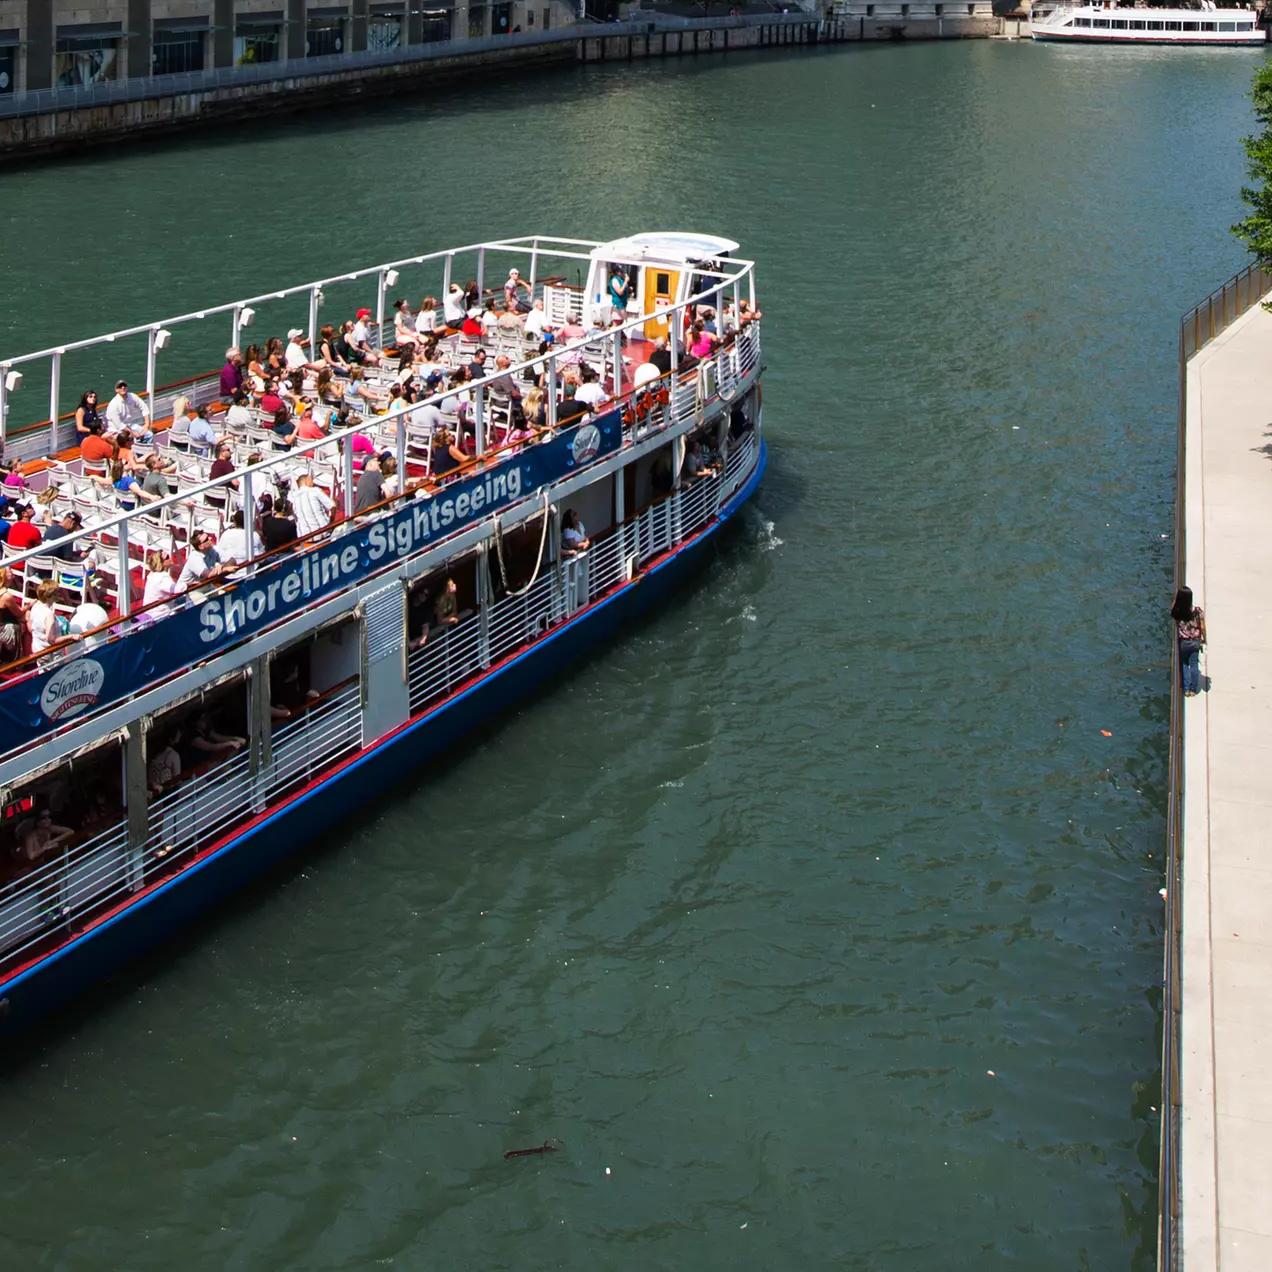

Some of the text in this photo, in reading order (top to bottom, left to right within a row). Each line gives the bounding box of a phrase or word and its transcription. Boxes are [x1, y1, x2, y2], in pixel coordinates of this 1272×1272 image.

[199, 466, 522, 643] Shoreline Sightseeing
[46, 669, 99, 703] Shoreline
